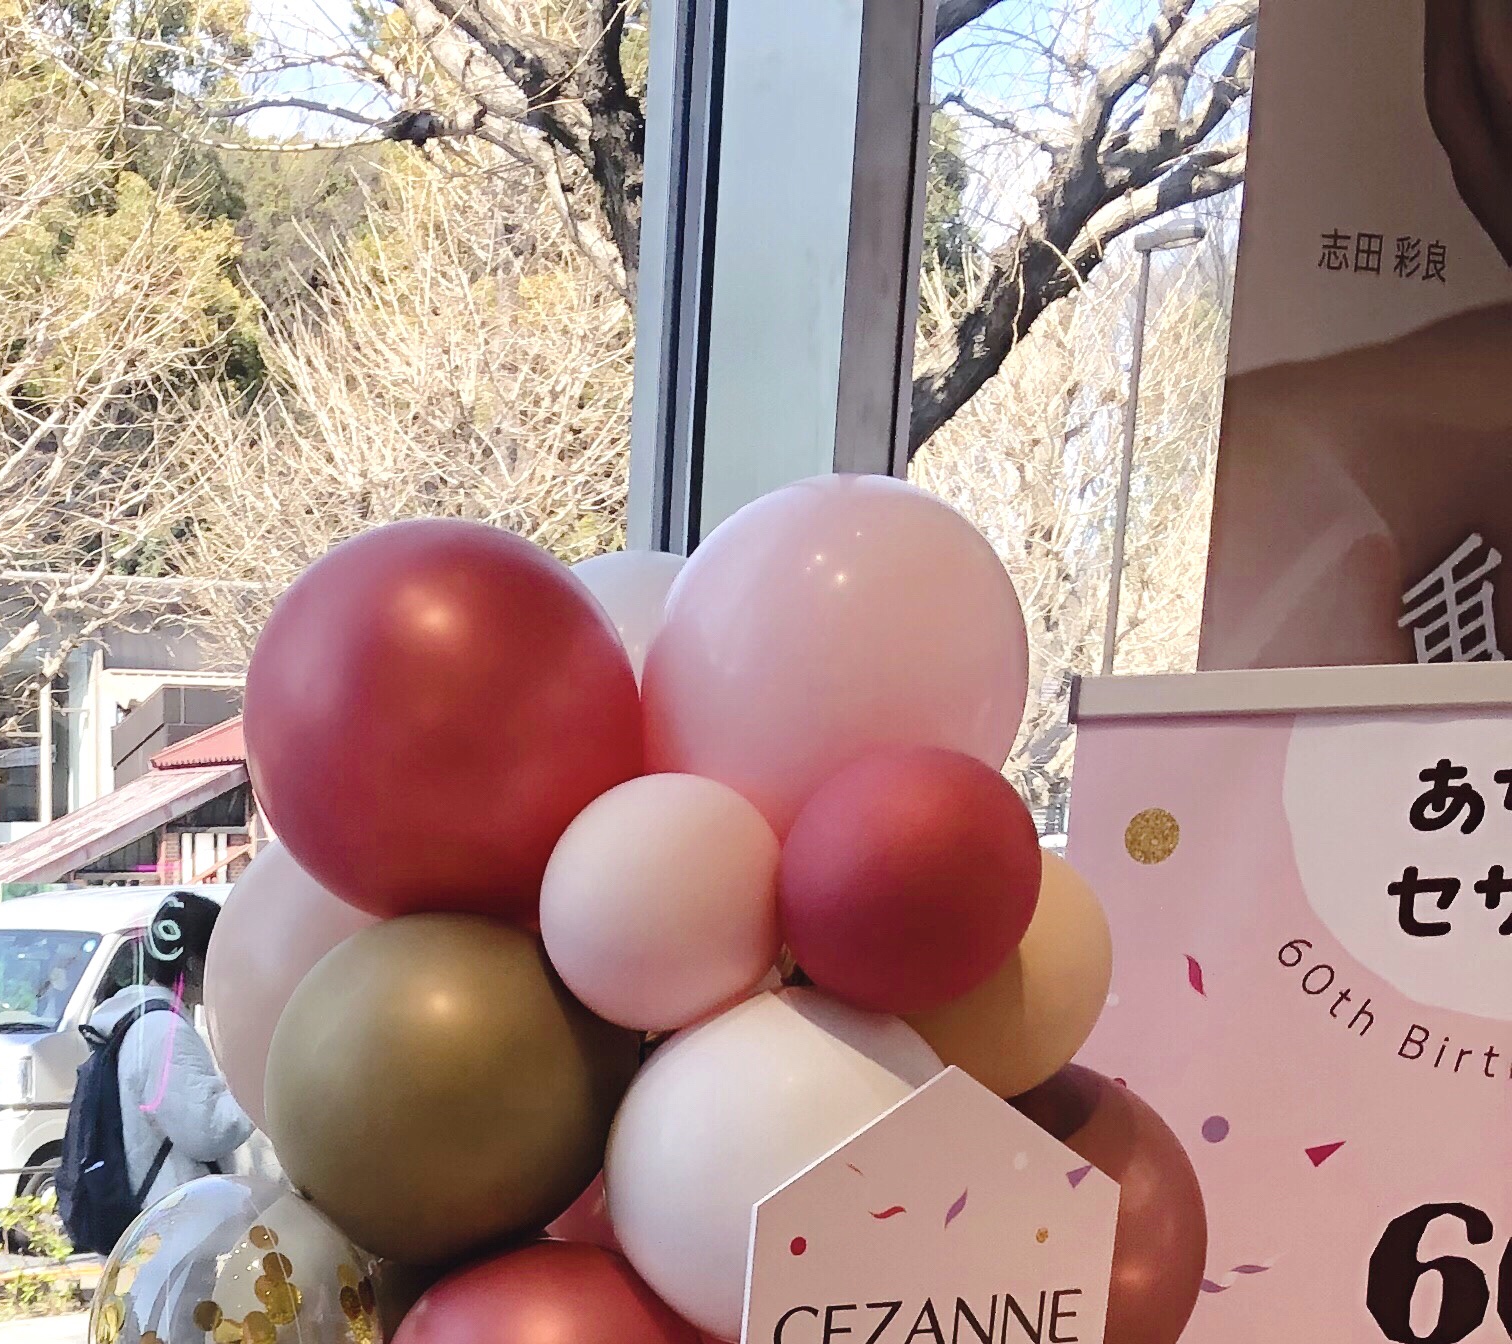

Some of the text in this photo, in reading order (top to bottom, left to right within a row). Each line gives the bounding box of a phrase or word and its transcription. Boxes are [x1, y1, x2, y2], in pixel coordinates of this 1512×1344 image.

[1317, 228, 1447, 283] 志田 彩良
[1277, 938, 1512, 1079] 60th Birt
